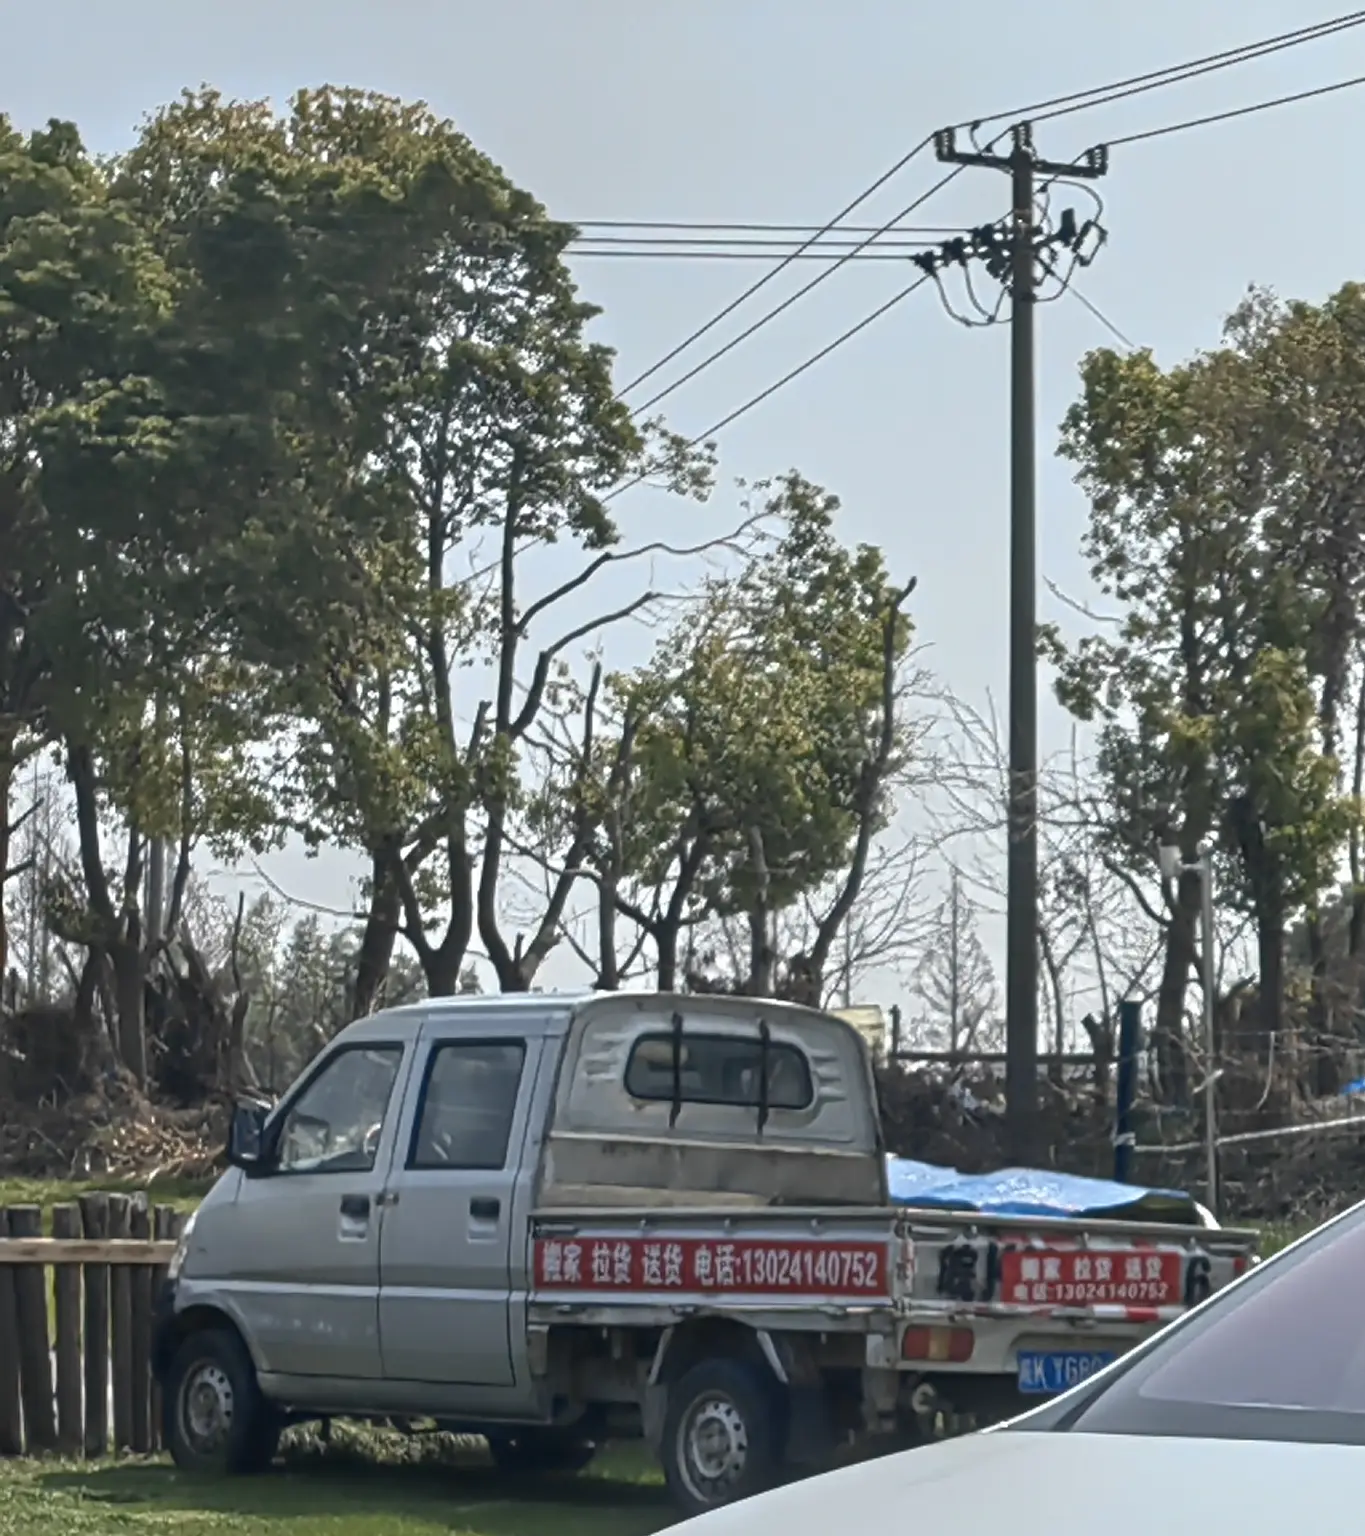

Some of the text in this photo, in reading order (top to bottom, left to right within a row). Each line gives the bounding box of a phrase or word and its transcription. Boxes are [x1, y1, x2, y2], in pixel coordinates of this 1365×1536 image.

[543, 1240, 582, 1283] 搬家
[592, 1240, 632, 1284] 拉货
[642, 1242, 683, 1286] 送货
